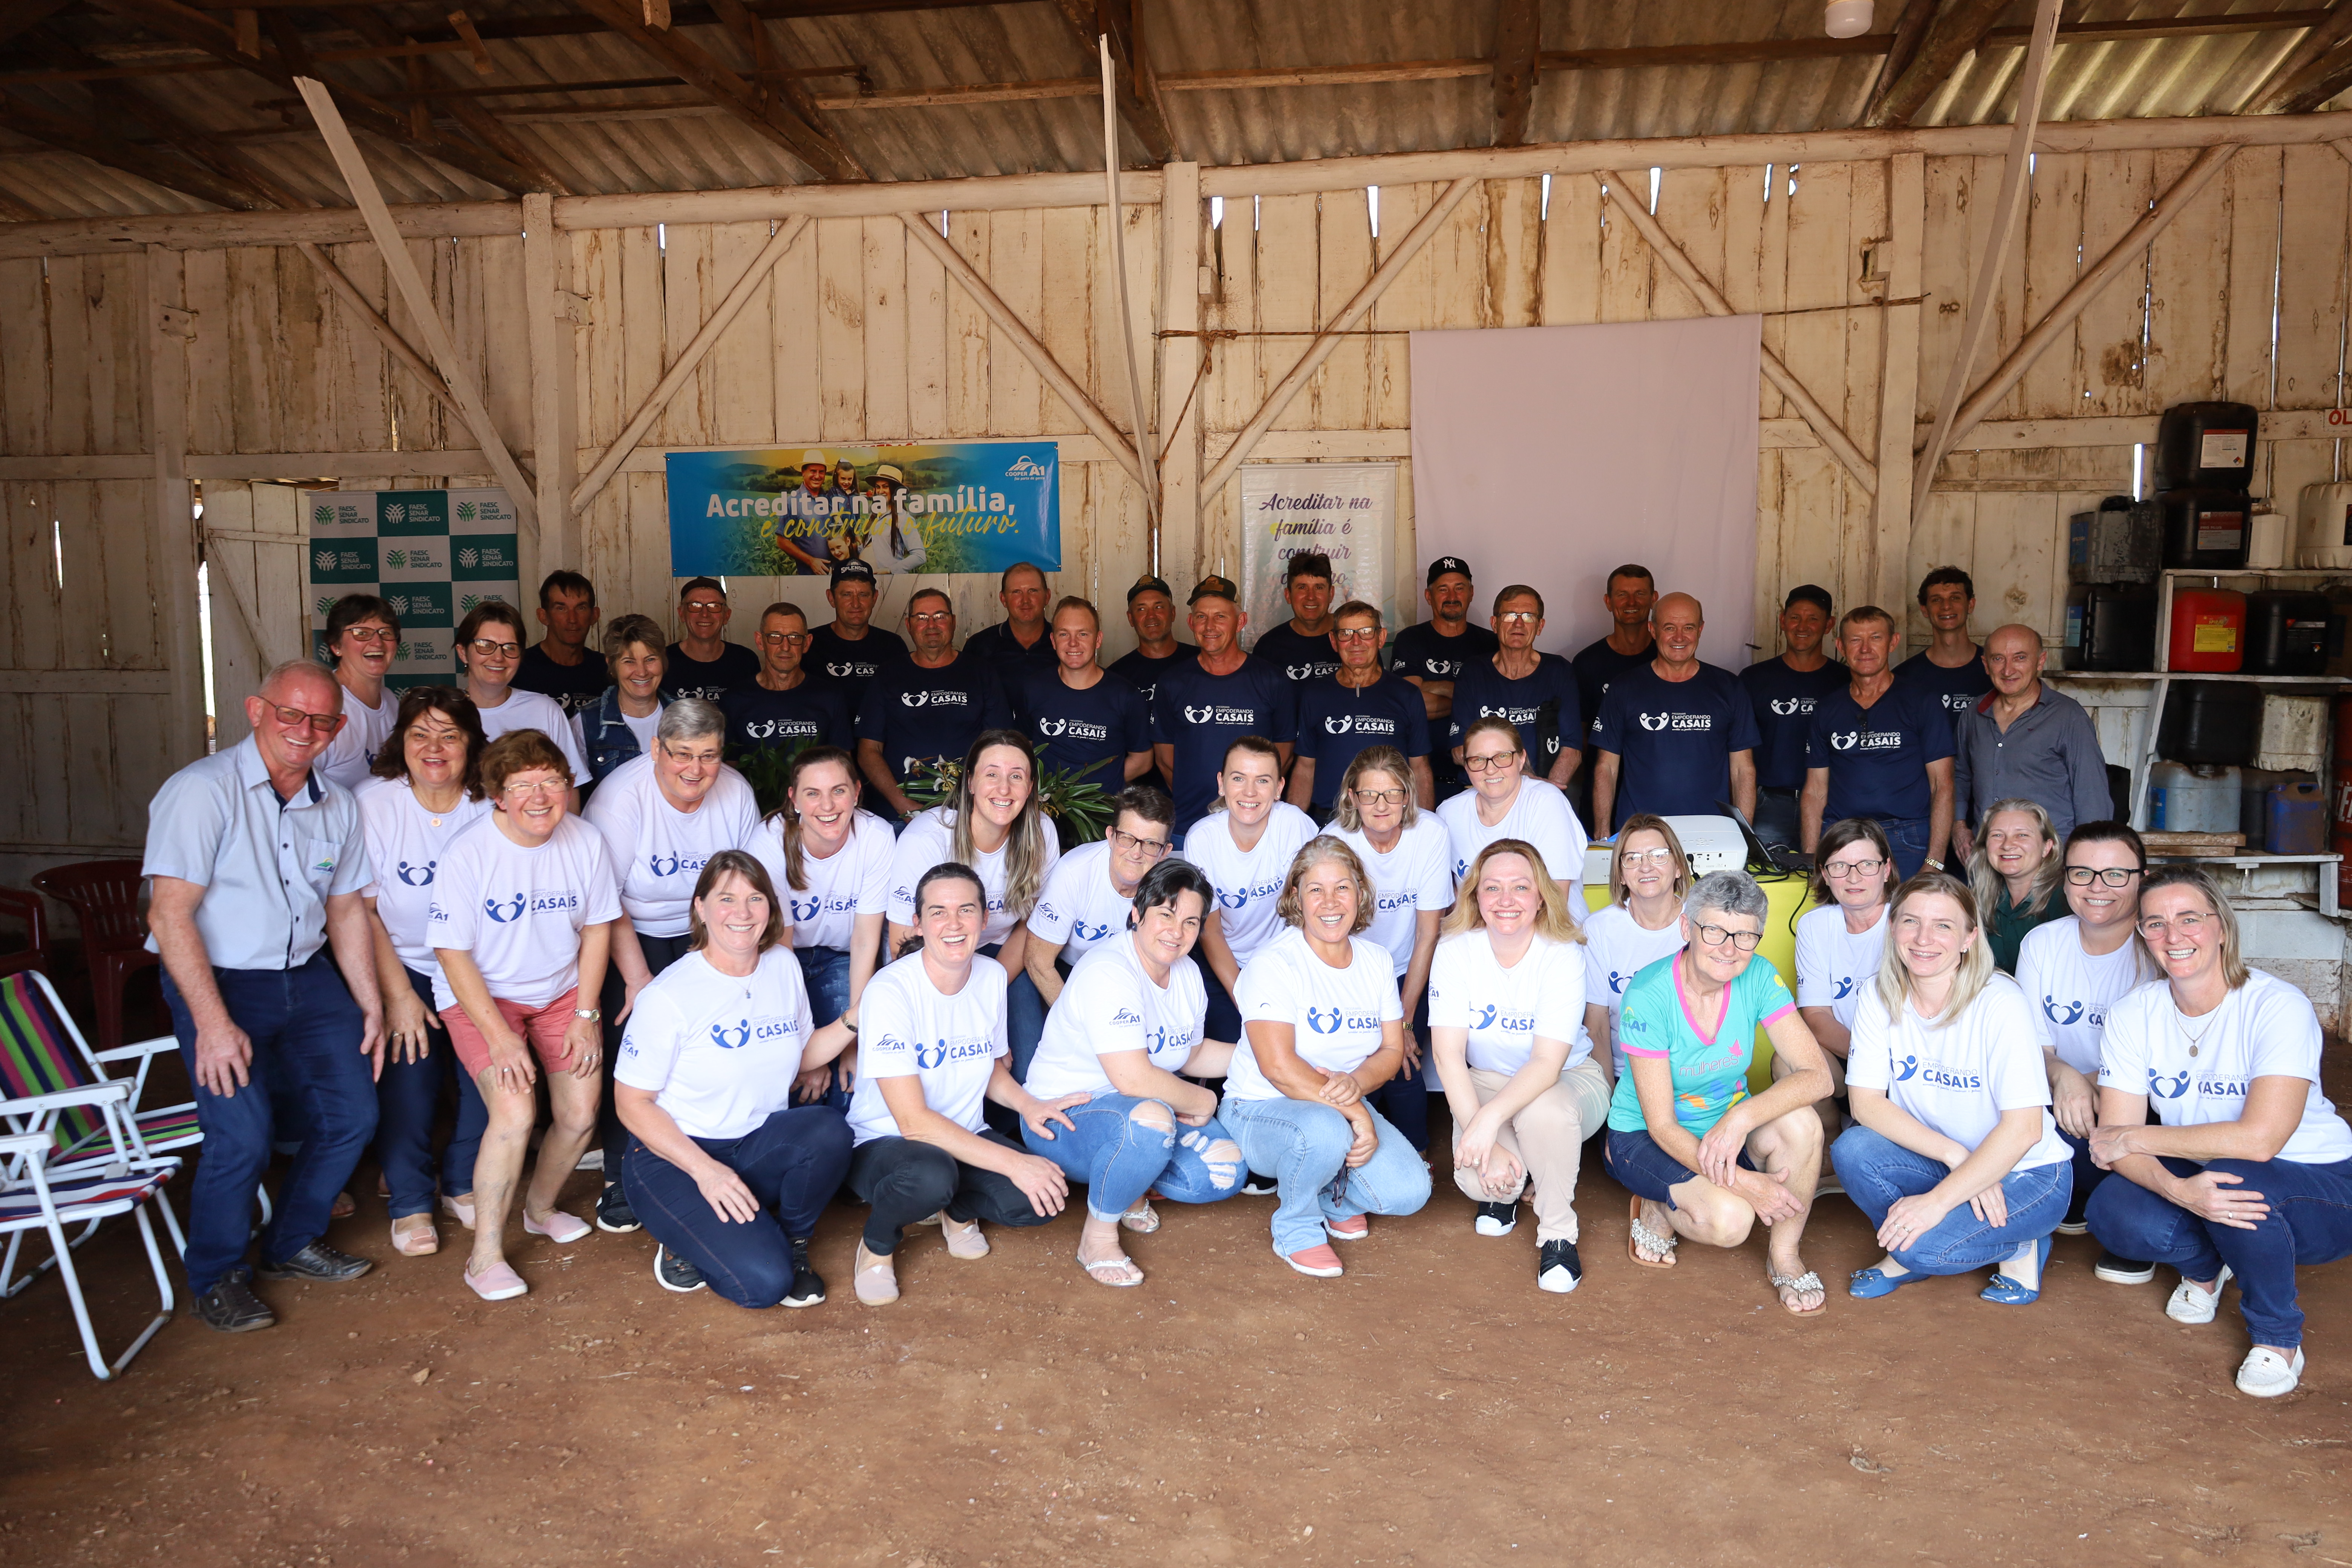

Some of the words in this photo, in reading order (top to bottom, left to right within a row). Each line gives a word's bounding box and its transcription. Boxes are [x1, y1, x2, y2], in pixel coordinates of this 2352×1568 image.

[1029, 466, 1045, 476] A1
[706, 490, 845, 518] Acreditar
[852, 495, 887, 514] na
[894, 484, 1015, 515] família,
[1259, 493, 1344, 511] Acreditar
[1349, 497, 1373, 509] na
[760, 512, 777, 538] é
[783, 507, 892, 538] construir
[903, 517, 920, 535] o
[923, 504, 1018, 548] futuro.
[1274, 518, 1336, 542] família
[1341, 518, 1352, 534] é
[841, 565, 868, 574] SPLENDOR
[931, 695, 967, 703] CASAIS
[1216, 713, 1254, 722] CASAIS
[779, 726, 818, 734] CASAIS
[1069, 722, 1107, 730] EMPODERANDO
[1355, 722, 1394, 732] CASAIS
[1068, 727, 1106, 738] CASAIS
[681, 859, 707, 870] CAS
[532, 896, 577, 911] CASAIS
[434, 912, 449, 921] A1
[1047, 913, 1058, 922] A1
[1130, 1015, 1140, 1023] A1
[1348, 1017, 1380, 1029] CASAI
[1501, 1017, 1534, 1030] CASA
[757, 1020, 798, 1038] CASAIS
[1631, 1020, 1647, 1032] A1
[892, 1042, 905, 1050] A1
[628, 1047, 638, 1057] A1
[1679, 1054, 1738, 1076] mulheres
[1923, 1062, 1977, 1076] EMPODERANDO
[1923, 1069, 1980, 1088] CASAIS
